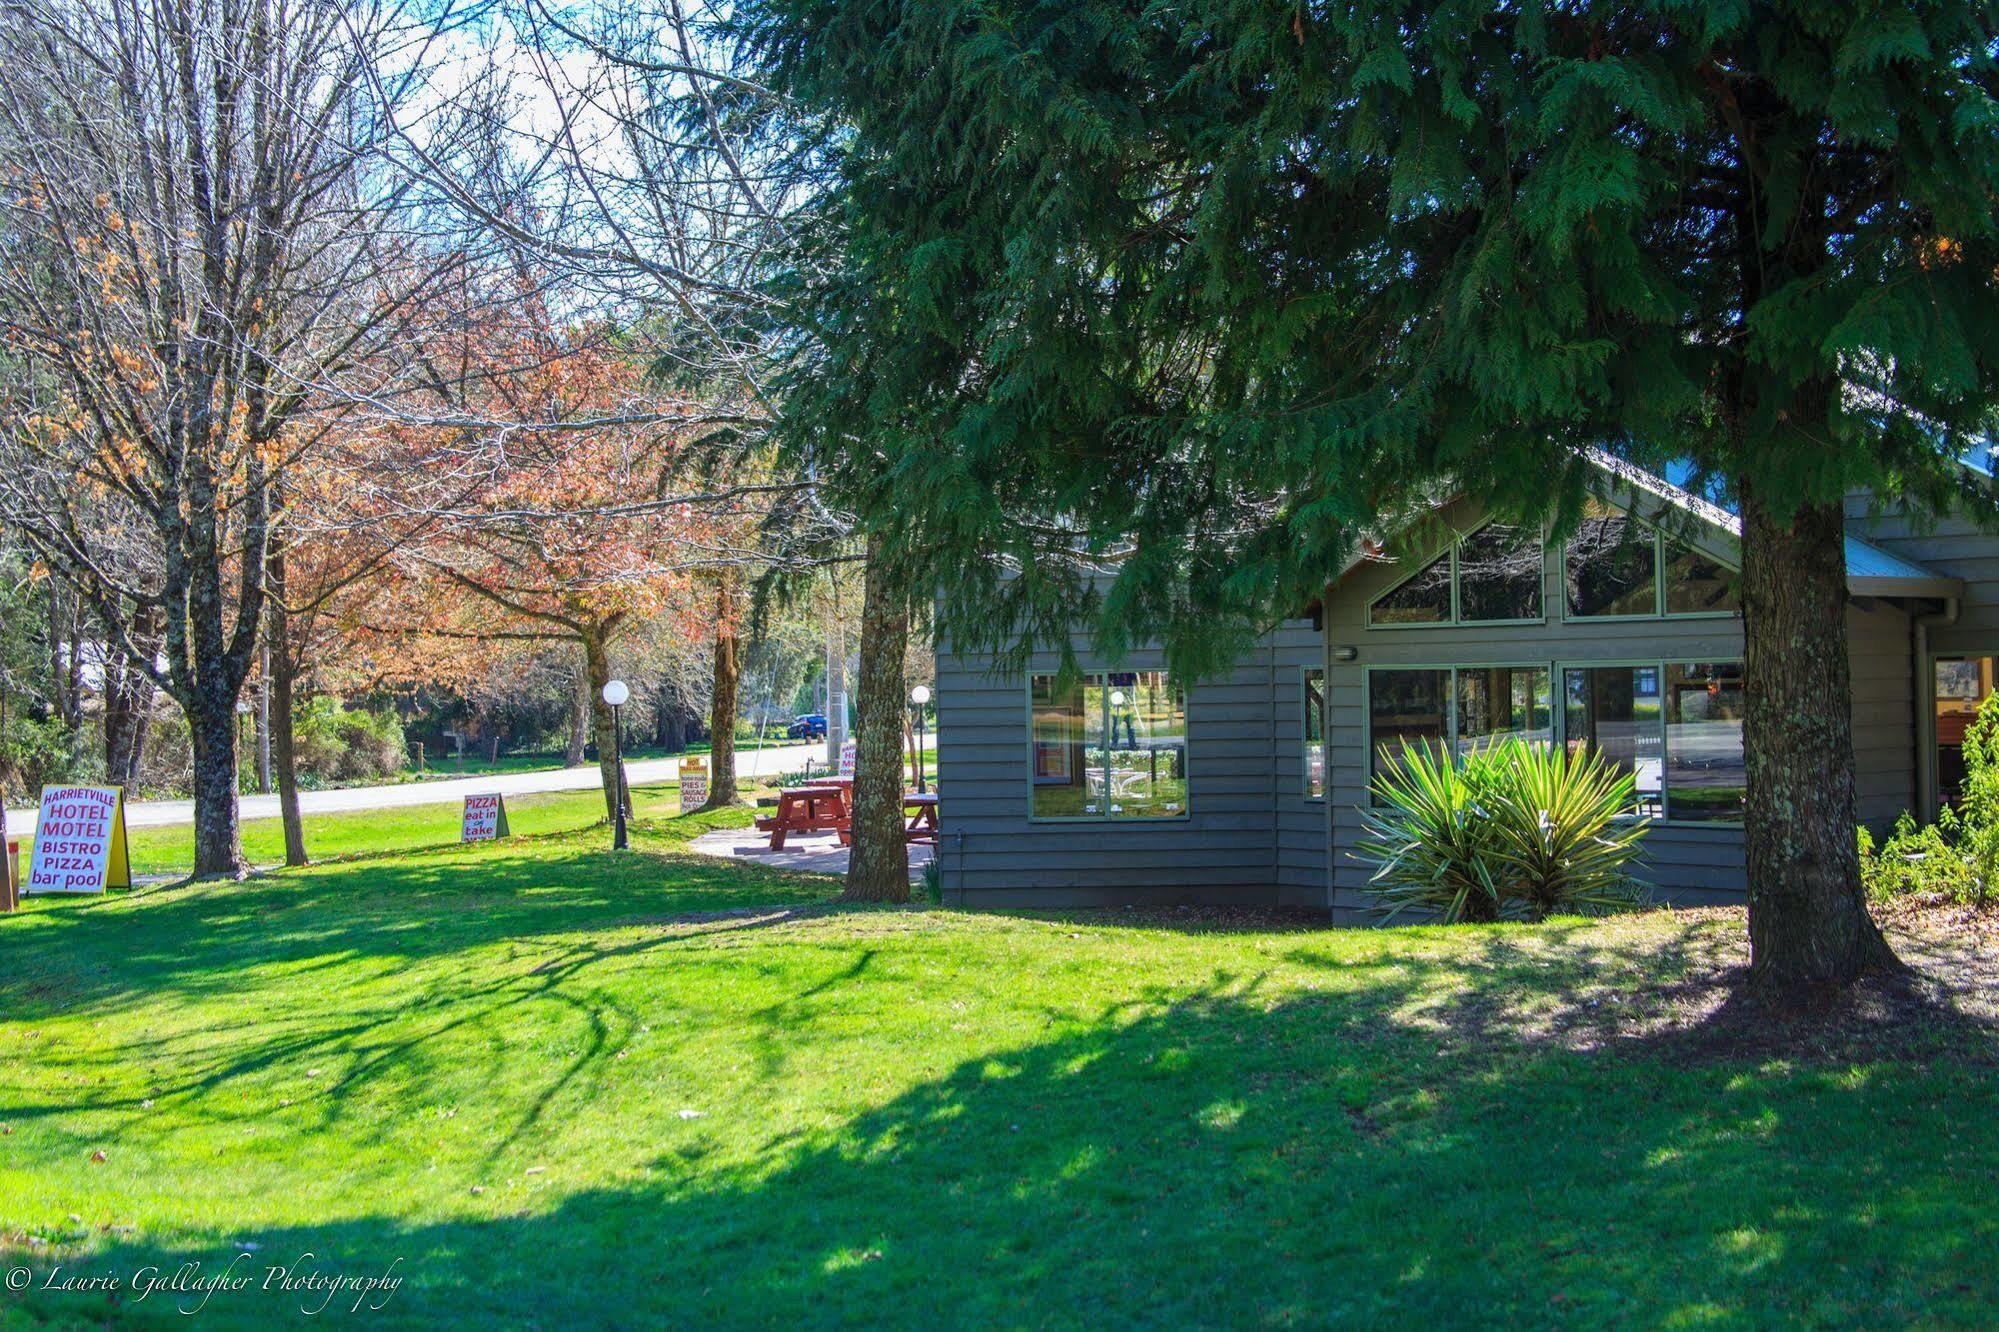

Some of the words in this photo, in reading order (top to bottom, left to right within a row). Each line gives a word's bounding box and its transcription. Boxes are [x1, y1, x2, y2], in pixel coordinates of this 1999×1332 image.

[681, 781, 700, 789] PIES
[44, 787, 116, 808] HARRIETVILLE
[466, 797, 497, 809] PIZZA
[683, 795, 706, 803] ROLLS
[49, 804, 109, 820] HOTEL
[465, 810, 484, 821] eat
[486, 808, 496, 819] in
[42, 821, 106, 838] MOTEL
[465, 825, 493, 836] take
[41, 841, 102, 855] BISTRO
[43, 857, 95, 870] PIZZA
[31, 869, 60, 885] bar
[64, 871, 103, 889] pool
